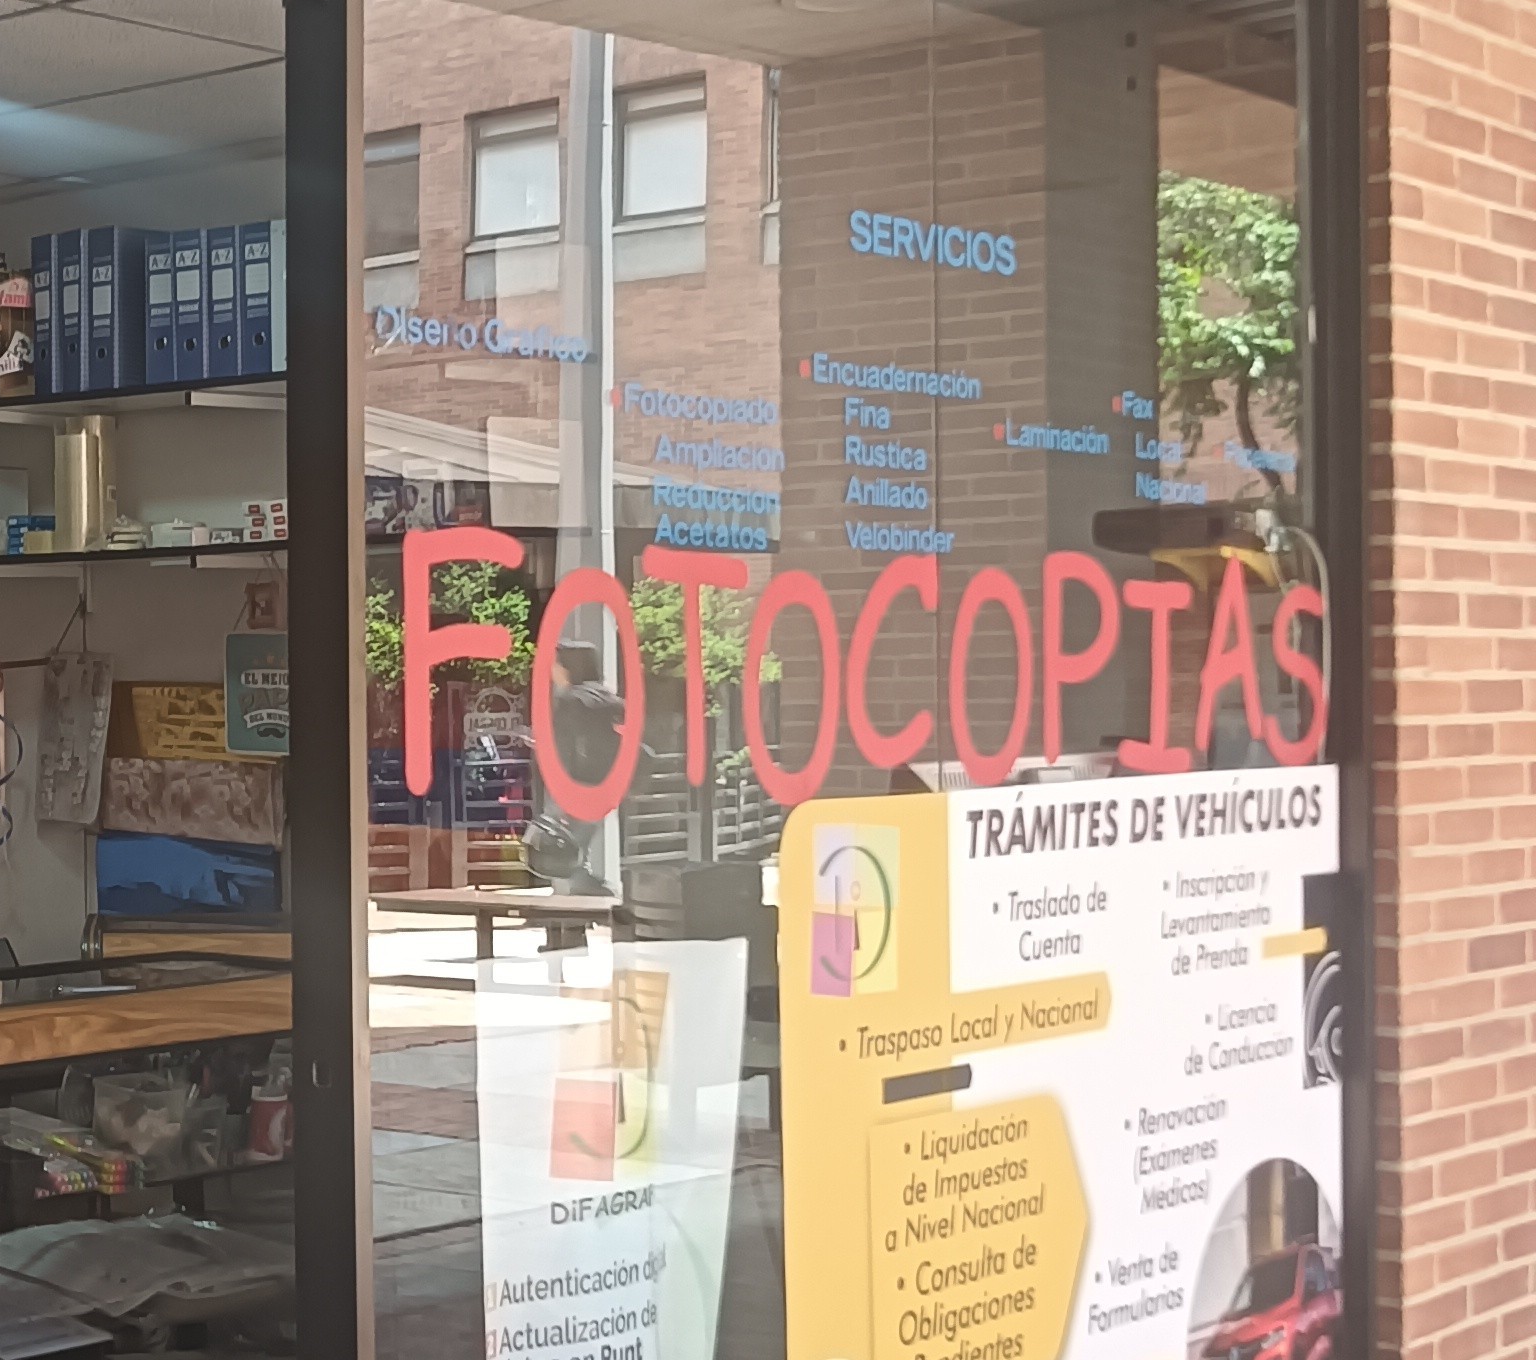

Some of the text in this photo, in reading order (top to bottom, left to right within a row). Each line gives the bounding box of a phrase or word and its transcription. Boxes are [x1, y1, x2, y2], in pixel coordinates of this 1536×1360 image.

[849, 209, 1019, 277] SERVICIOS
[812, 352, 983, 400] Encuadernación
[623, 382, 779, 426] Fotocopiado
[844, 396, 891, 431] Fina
[1122, 390, 1155, 421] Fax
[844, 435, 928, 471] Rustica
[1005, 418, 1110, 455] Laminación
[845, 475, 929, 510] Anillado
[1135, 472, 1208, 506] Nacional
[654, 513, 769, 551] Acetatos
[845, 520, 955, 554] Velobinder
[402, 525, 1329, 822] FOTOCOPIAS
[966, 778, 1323, 859] TRÁMITES DE VEHÍCULOS
[1007, 880, 1107, 922] Traslado de
[1260, 869, 1271, 896] y
[1160, 904, 1271, 939] Levantamiento
[1018, 930, 1082, 962] Cuenta
[1170, 938, 1249, 976] de Prenda
[856, 986, 1099, 1062] Traspaso Local y Nacional
[1217, 998, 1277, 1031] Licencia
[1183, 1044, 1204, 1076] de
[920, 1113, 1029, 1164] Liquidación
[902, 1156, 1029, 1206] de Impuestos
[884, 1181, 1047, 1252] a Nivel Nacional
[499, 1259, 640, 1307] Autenticación
[915, 1233, 1037, 1296] Consulta de
[1107, 1240, 1180, 1286] Venta de
[499, 1306, 637, 1355] Actualización
[641, 1298, 658, 1329] de
[898, 1286, 1037, 1346] Obligaciones
[1087, 1283, 1185, 1335] Formularios
